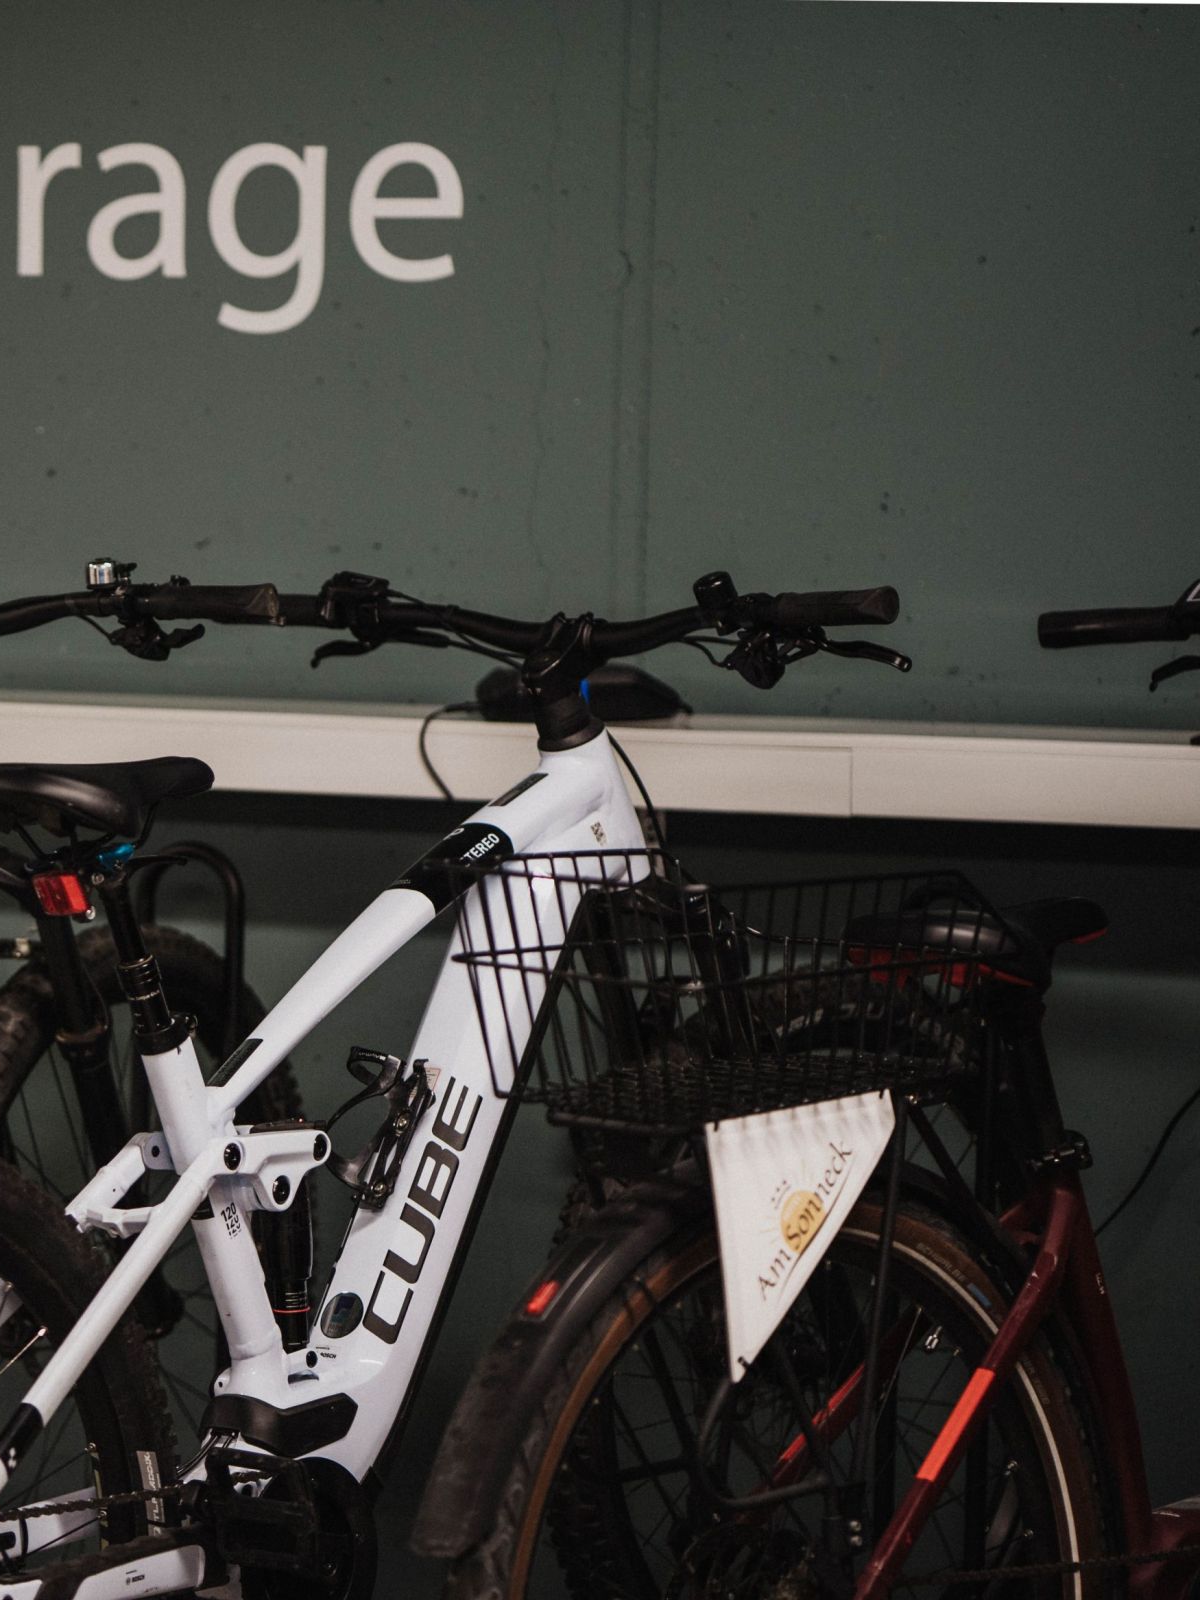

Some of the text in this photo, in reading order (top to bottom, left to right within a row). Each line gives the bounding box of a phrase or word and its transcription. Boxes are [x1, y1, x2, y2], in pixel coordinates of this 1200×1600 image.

[362, 1076, 484, 1345] CUBE
[759, 1141, 853, 1302] Am Sonneck
